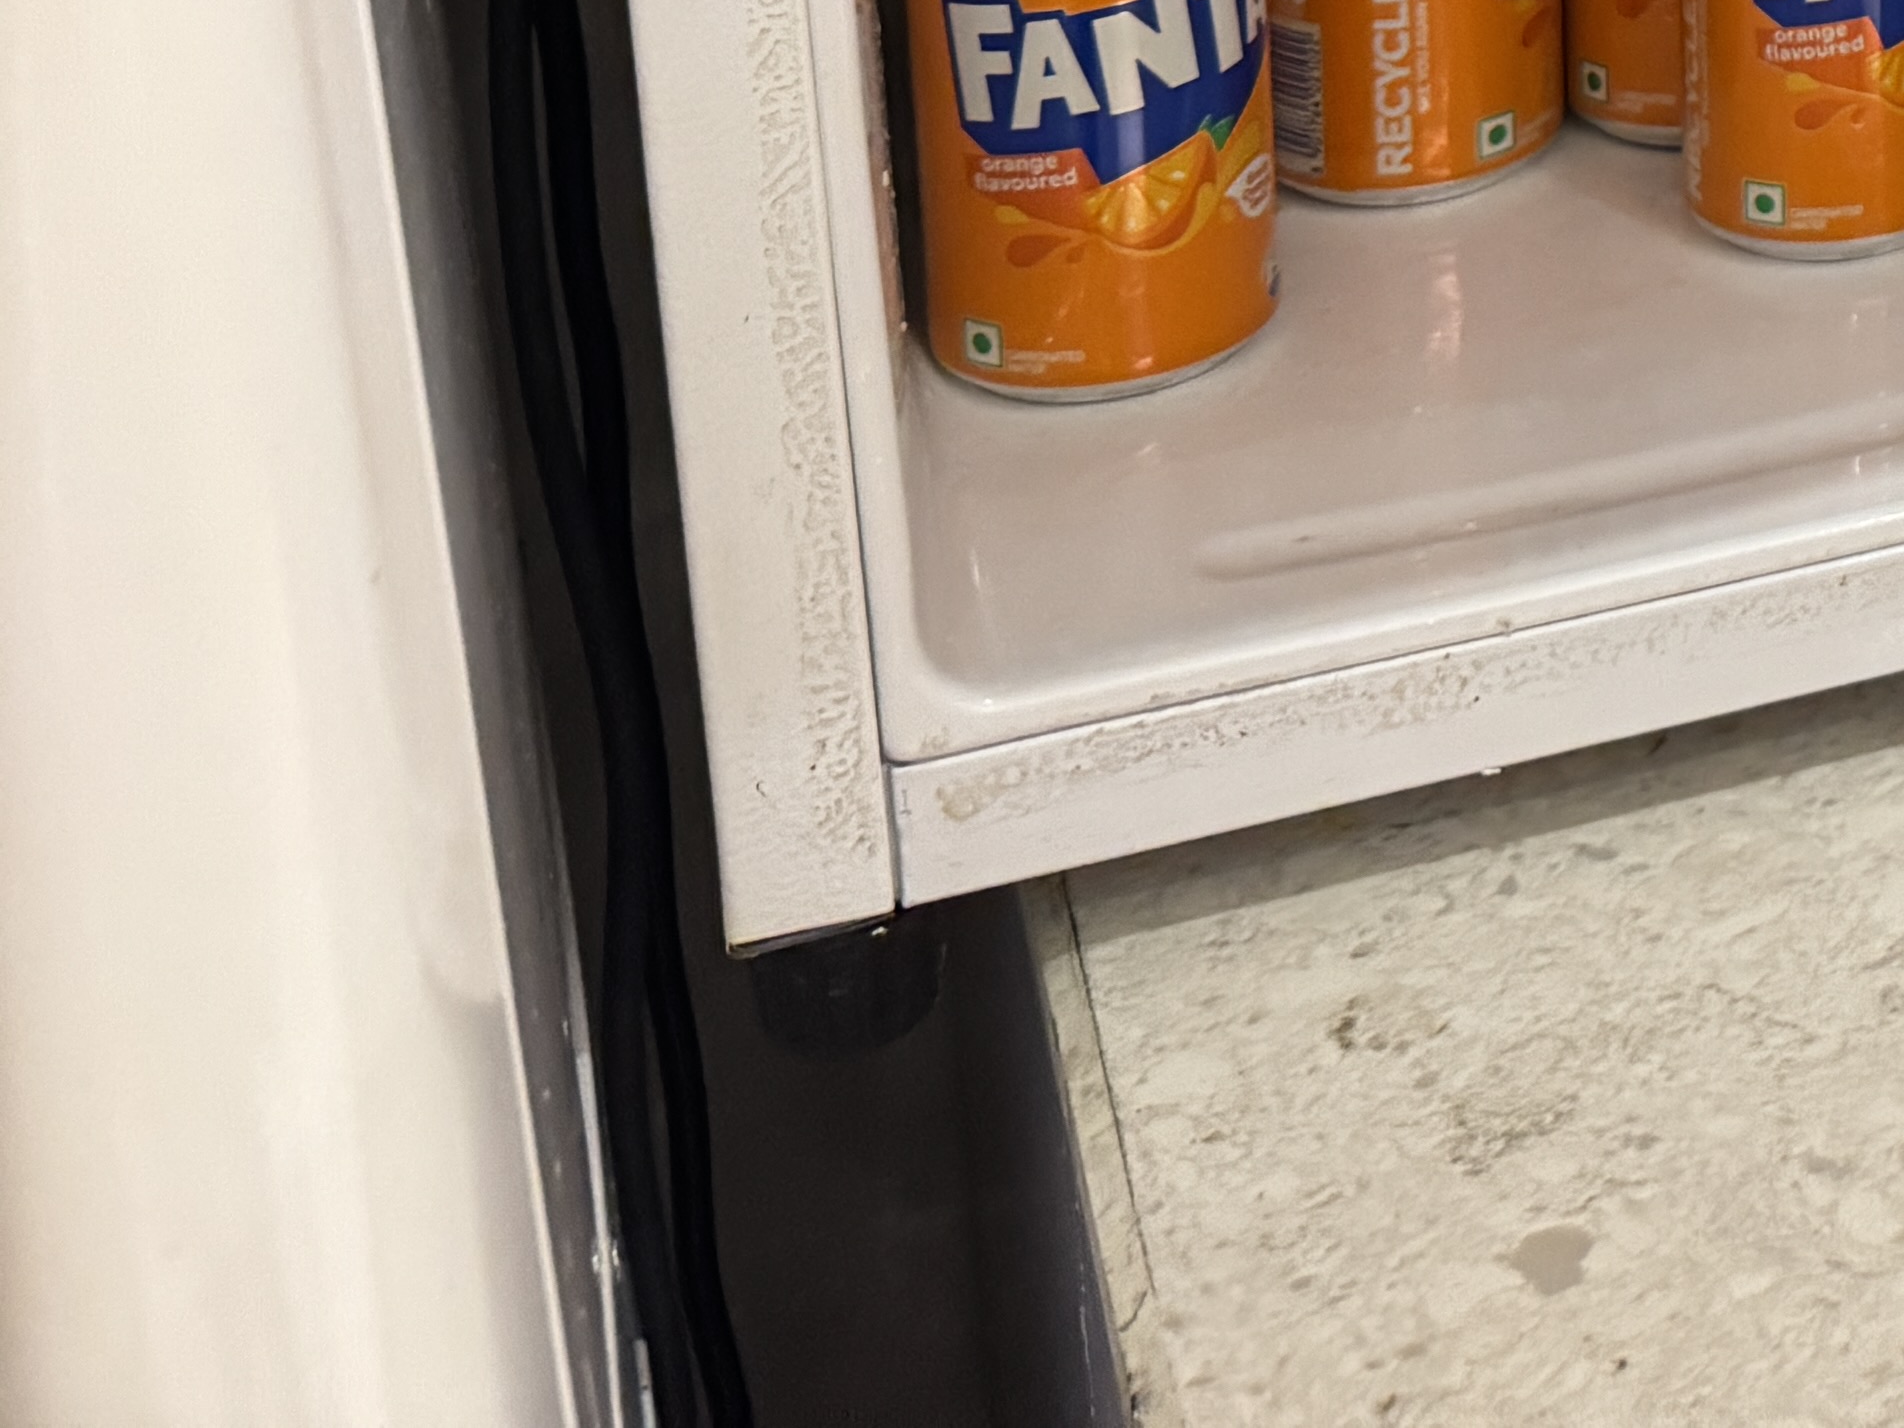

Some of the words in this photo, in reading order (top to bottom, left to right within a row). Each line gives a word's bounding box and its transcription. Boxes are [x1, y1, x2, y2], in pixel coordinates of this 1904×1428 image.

[1774, 24, 1848, 44] orange
[1765, 36, 1864, 61] flavoured
[981, 155, 1059, 175] orange
[974, 168, 1078, 192] flavoured
